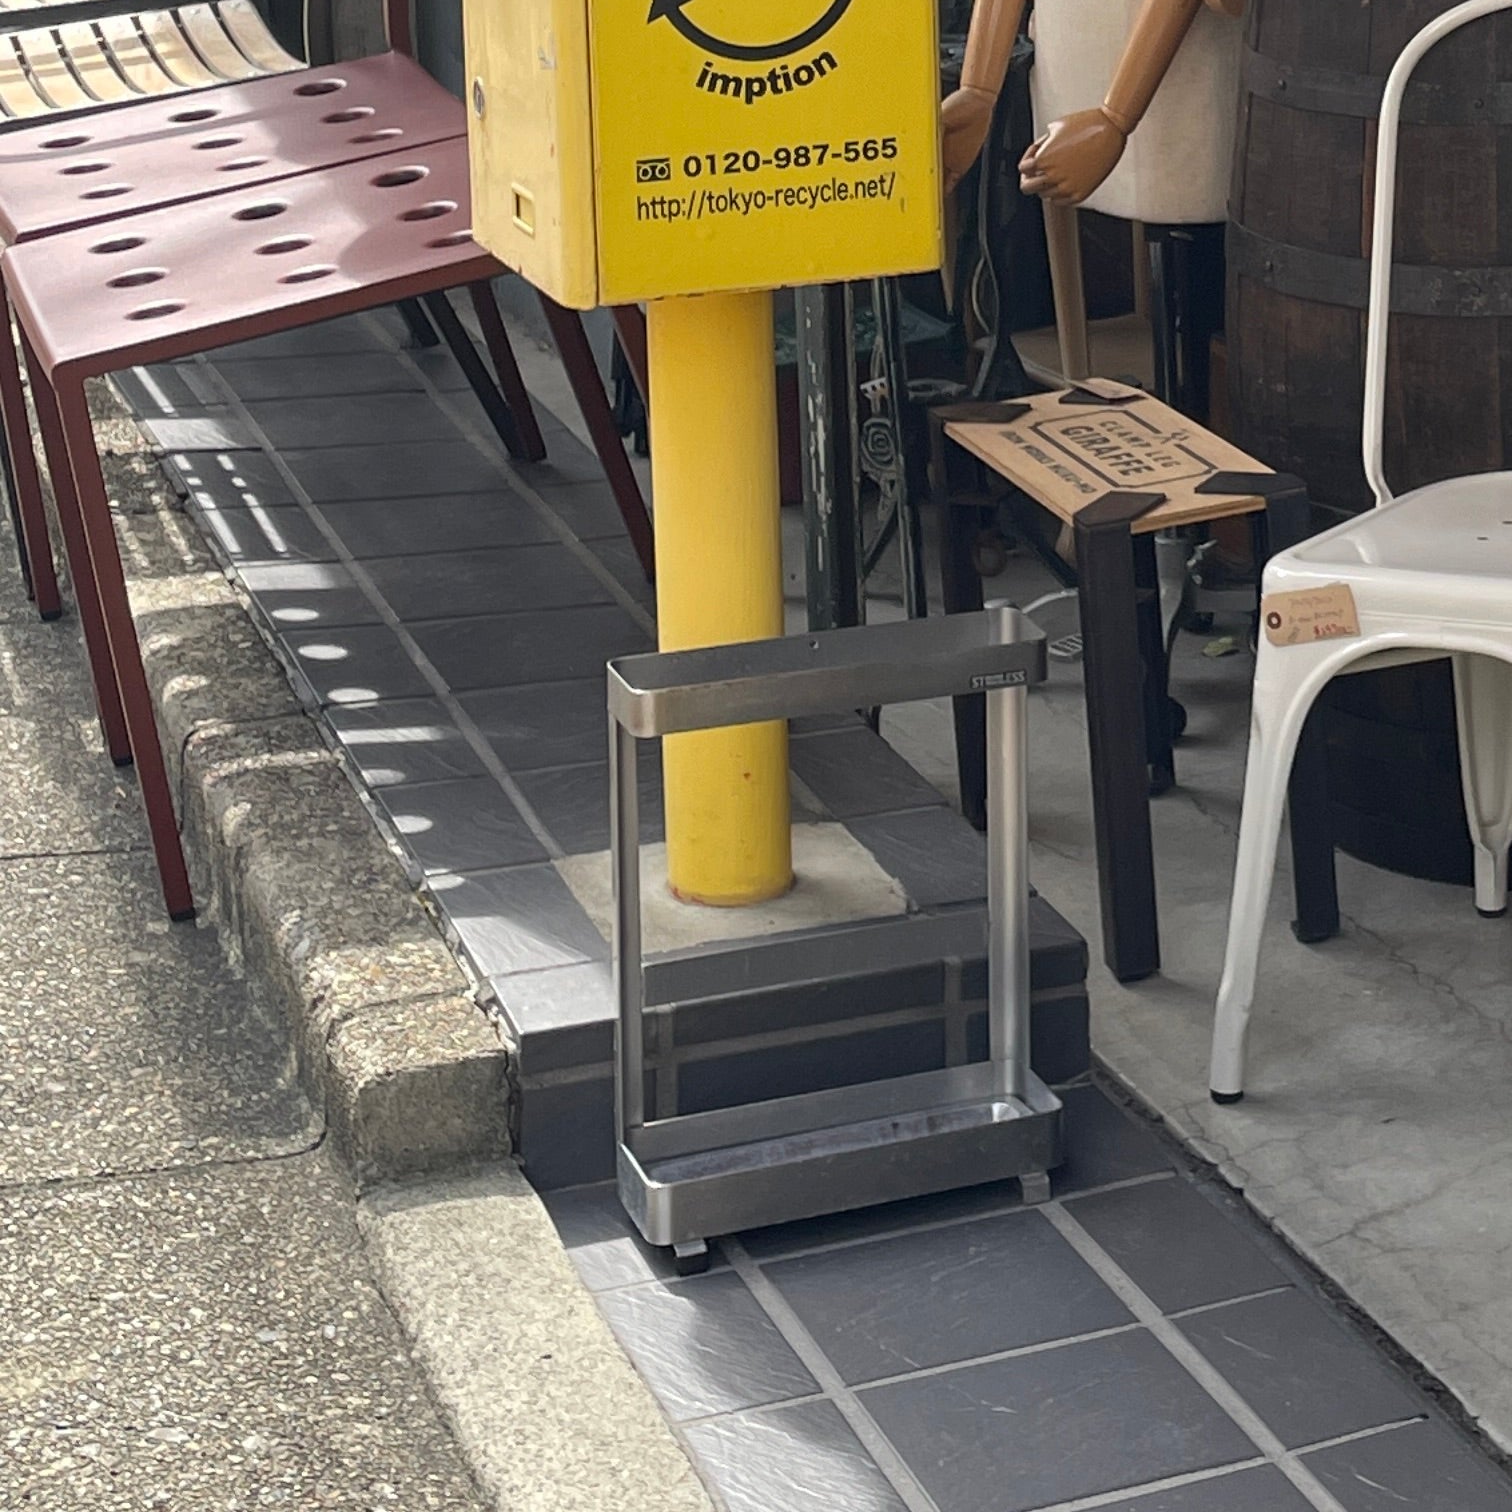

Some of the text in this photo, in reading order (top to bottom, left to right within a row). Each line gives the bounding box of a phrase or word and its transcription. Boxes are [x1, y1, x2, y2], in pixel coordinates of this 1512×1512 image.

[696, 51, 838, 104] imption
[683, 137, 898, 178] 0120-987-565
[636, 172, 896, 224] http://tokyo-recycle.net/
[1060, 425, 1155, 477] GIRAFFE
